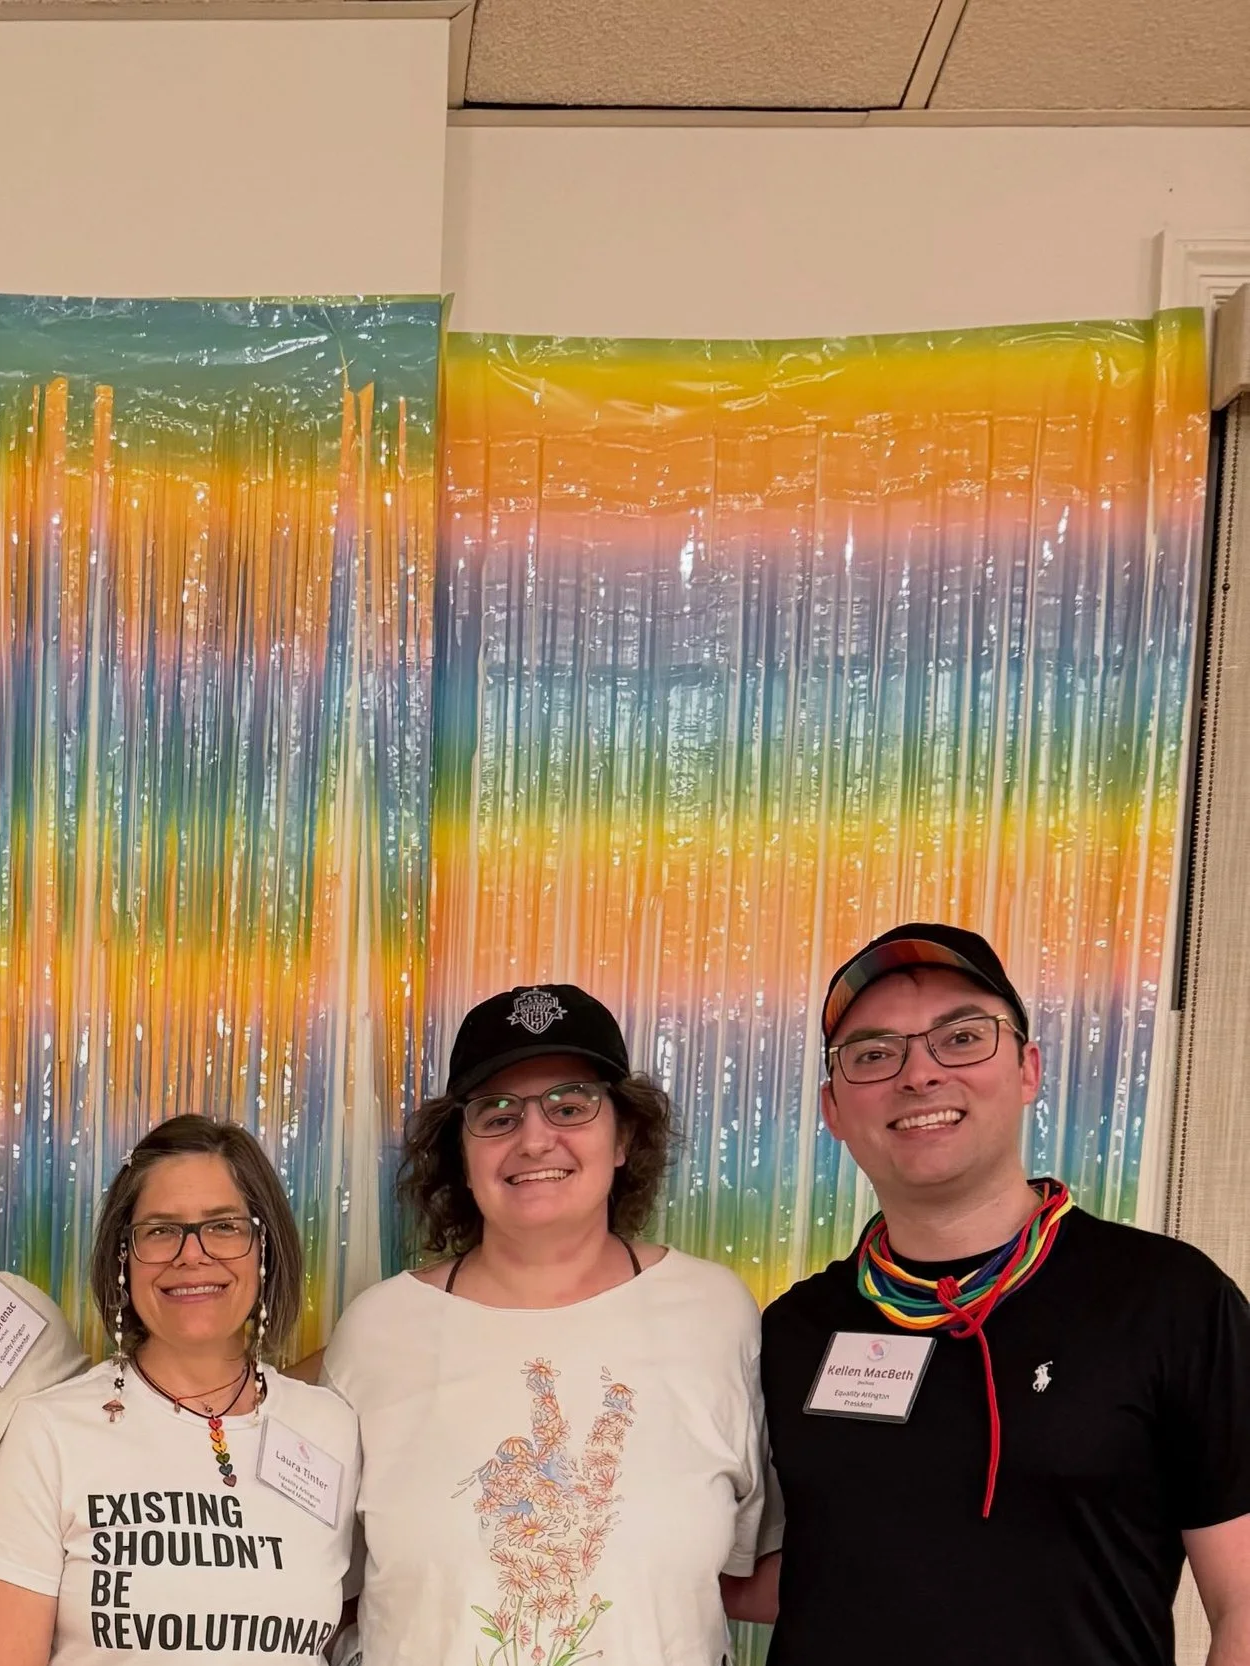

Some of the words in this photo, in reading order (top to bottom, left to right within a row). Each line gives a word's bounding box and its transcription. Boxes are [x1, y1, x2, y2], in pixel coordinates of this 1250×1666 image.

[827, 1365, 861, 1377] Kellen
[864, 1368, 914, 1380] MacBeth
[835, 1389, 860, 1398] Equality
[861, 1391, 890, 1400] Arlington
[844, 1400, 873, 1408] President
[276, 1450, 301, 1473] Laura
[304, 1468, 328, 1490] Tinter
[88, 1492, 243, 1528] EXISTING
[91, 1530, 283, 1569] SHOULDN'T
[91, 1569, 132, 1608] BE
[91, 1611, 336, 1656] REVOLUTIONAR
